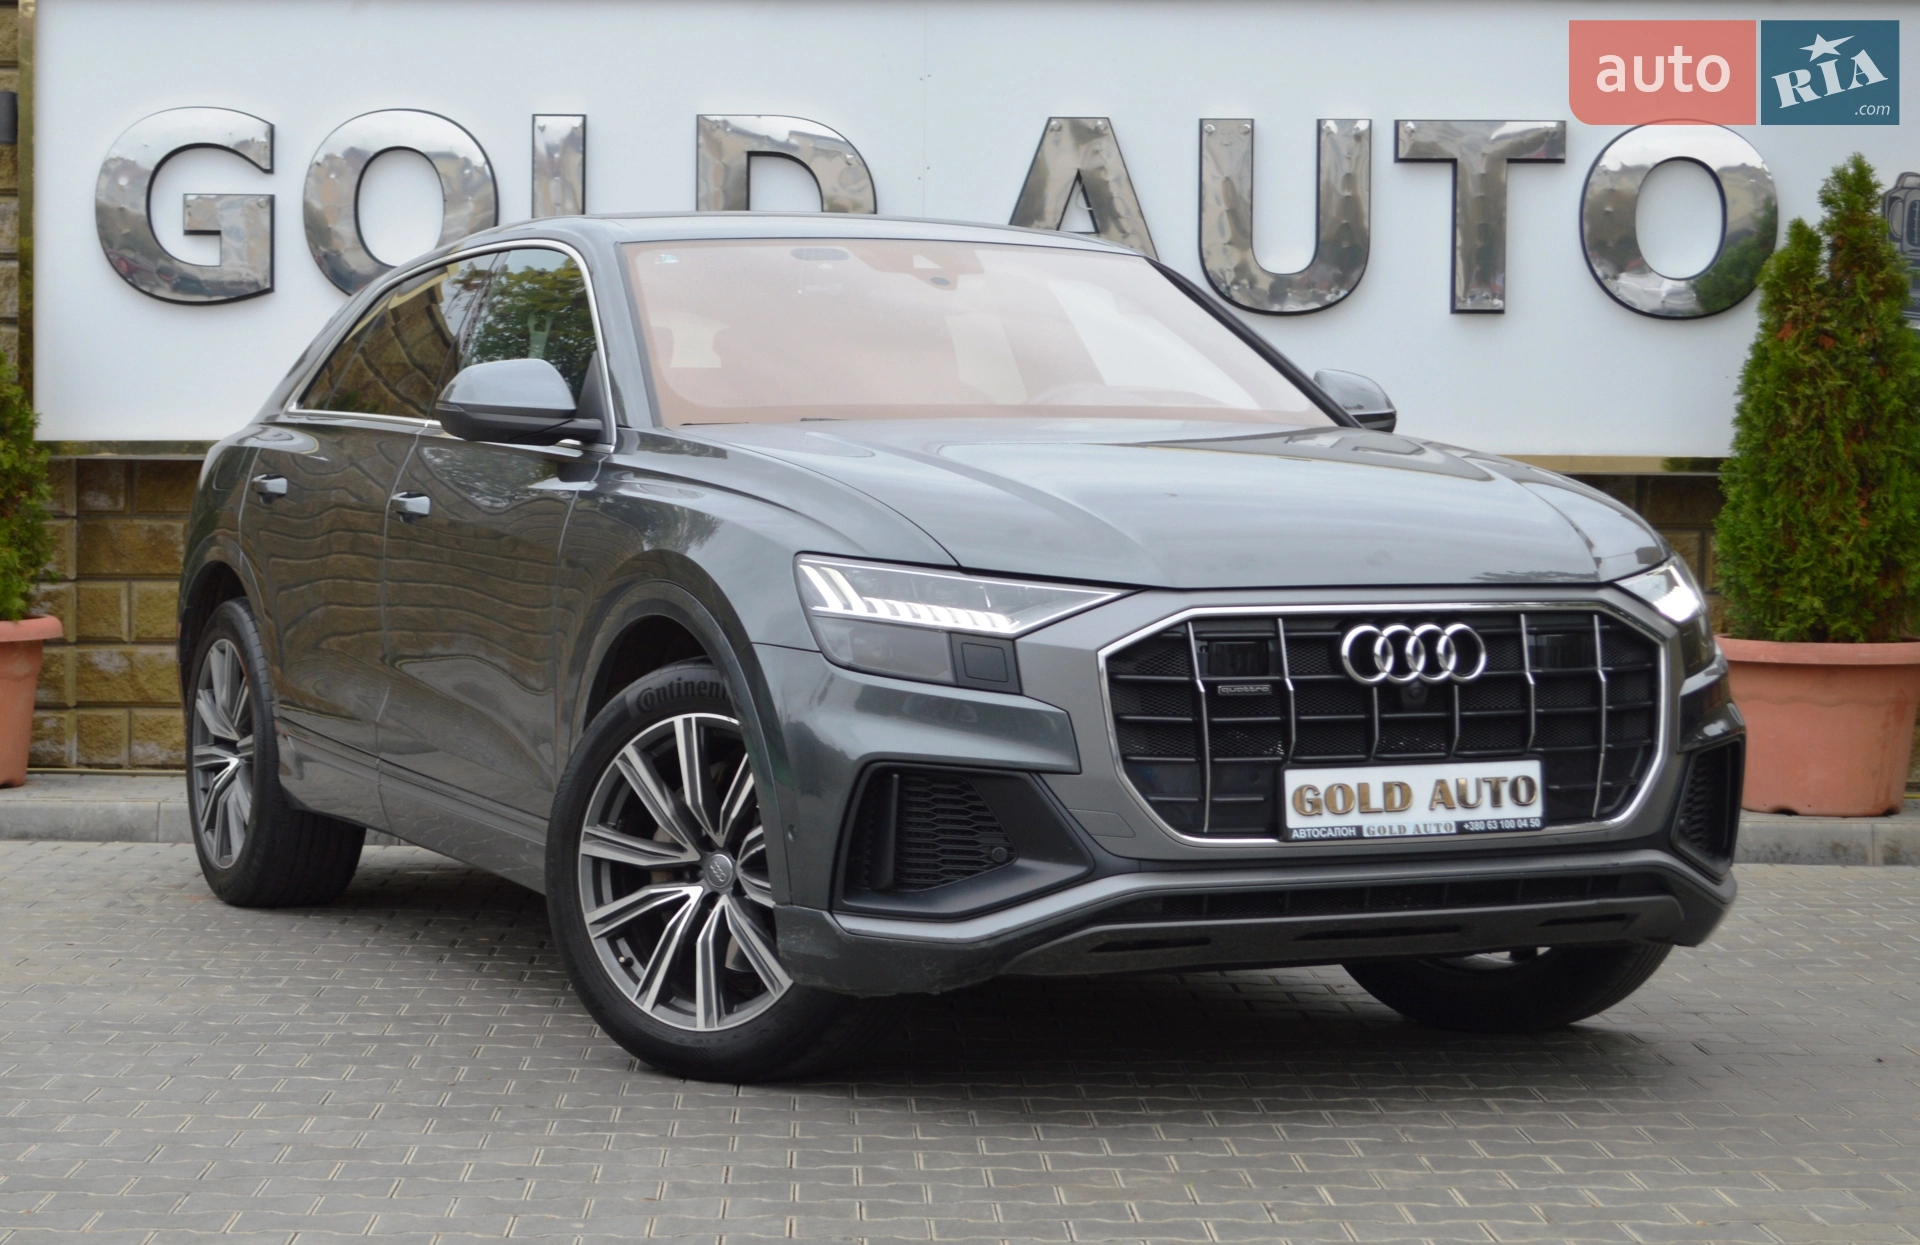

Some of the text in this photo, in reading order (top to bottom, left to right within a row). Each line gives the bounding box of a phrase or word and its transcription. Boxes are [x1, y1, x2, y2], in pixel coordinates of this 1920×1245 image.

[1008, 117, 1778, 320] AUTO
[1221, 686, 1269, 694] quattro
[1292, 775, 1538, 816] GOLD AUTO
[1366, 822, 1454, 836] GOLD AUTO
[1463, 818, 1541, 831] +380 63 100 04 50
[1291, 826, 1357, 839] АВТОСАЛОН
